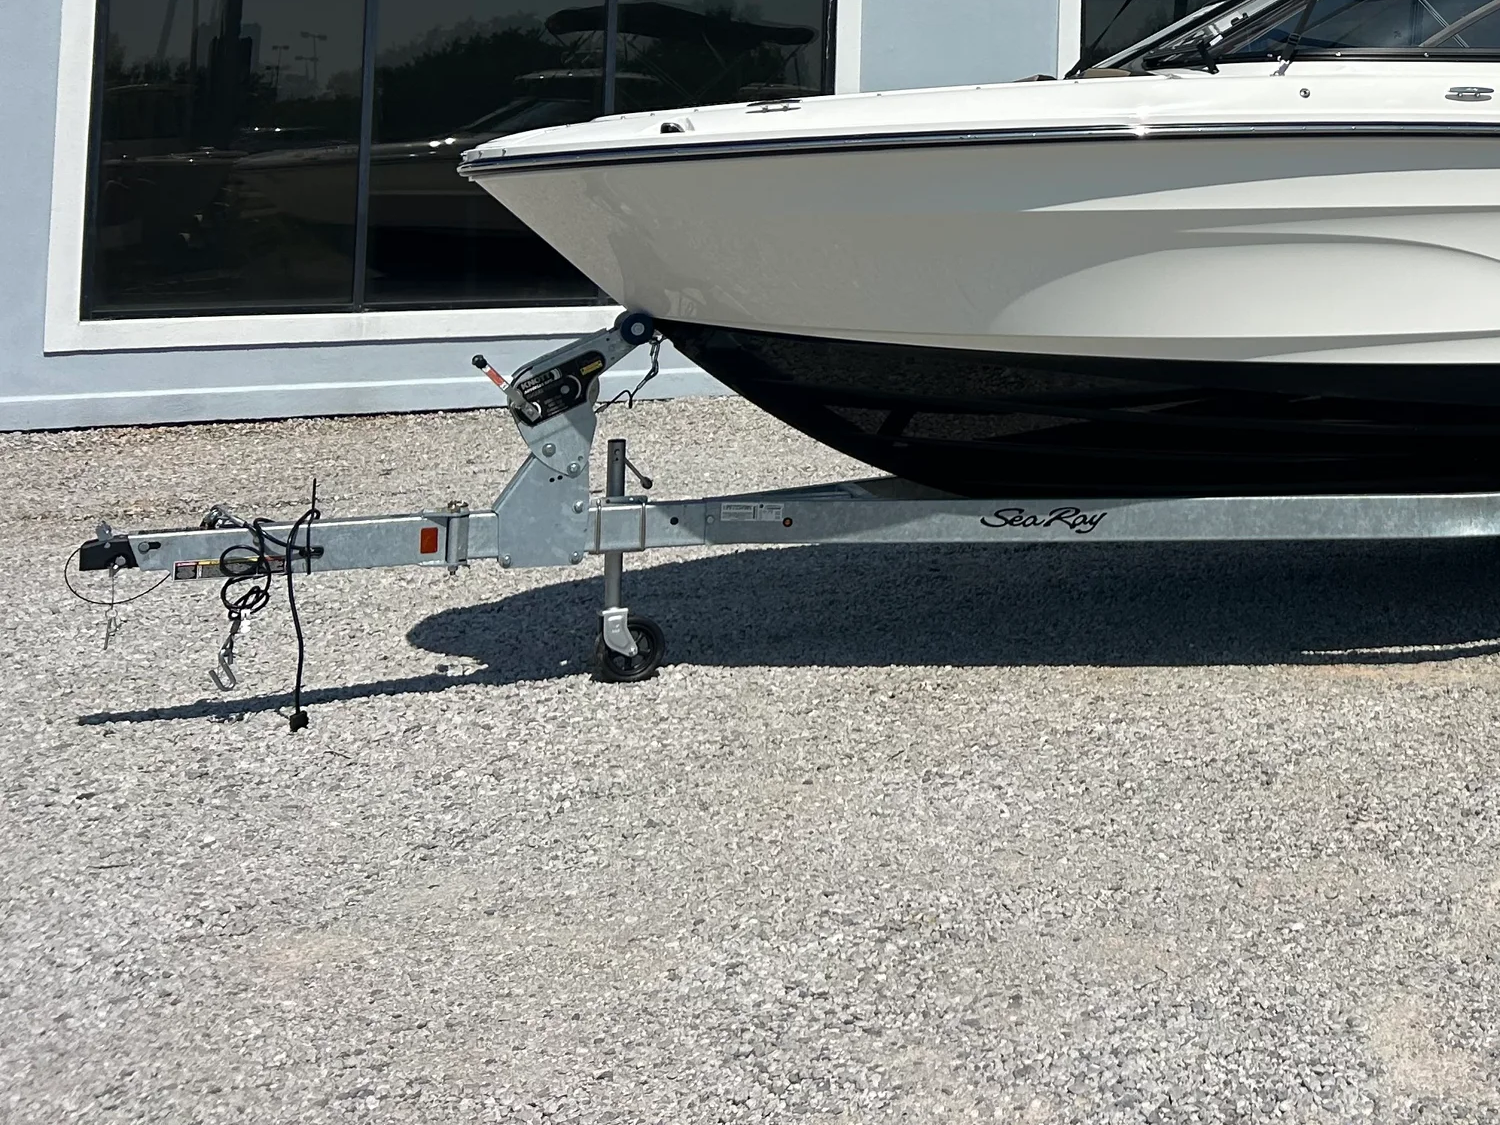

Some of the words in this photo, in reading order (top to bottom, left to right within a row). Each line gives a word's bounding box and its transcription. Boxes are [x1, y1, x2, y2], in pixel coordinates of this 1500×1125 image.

[520, 372, 552, 391] KNOTT
[980, 508, 1045, 527] Sea
[1043, 507, 1108, 534] Ray
